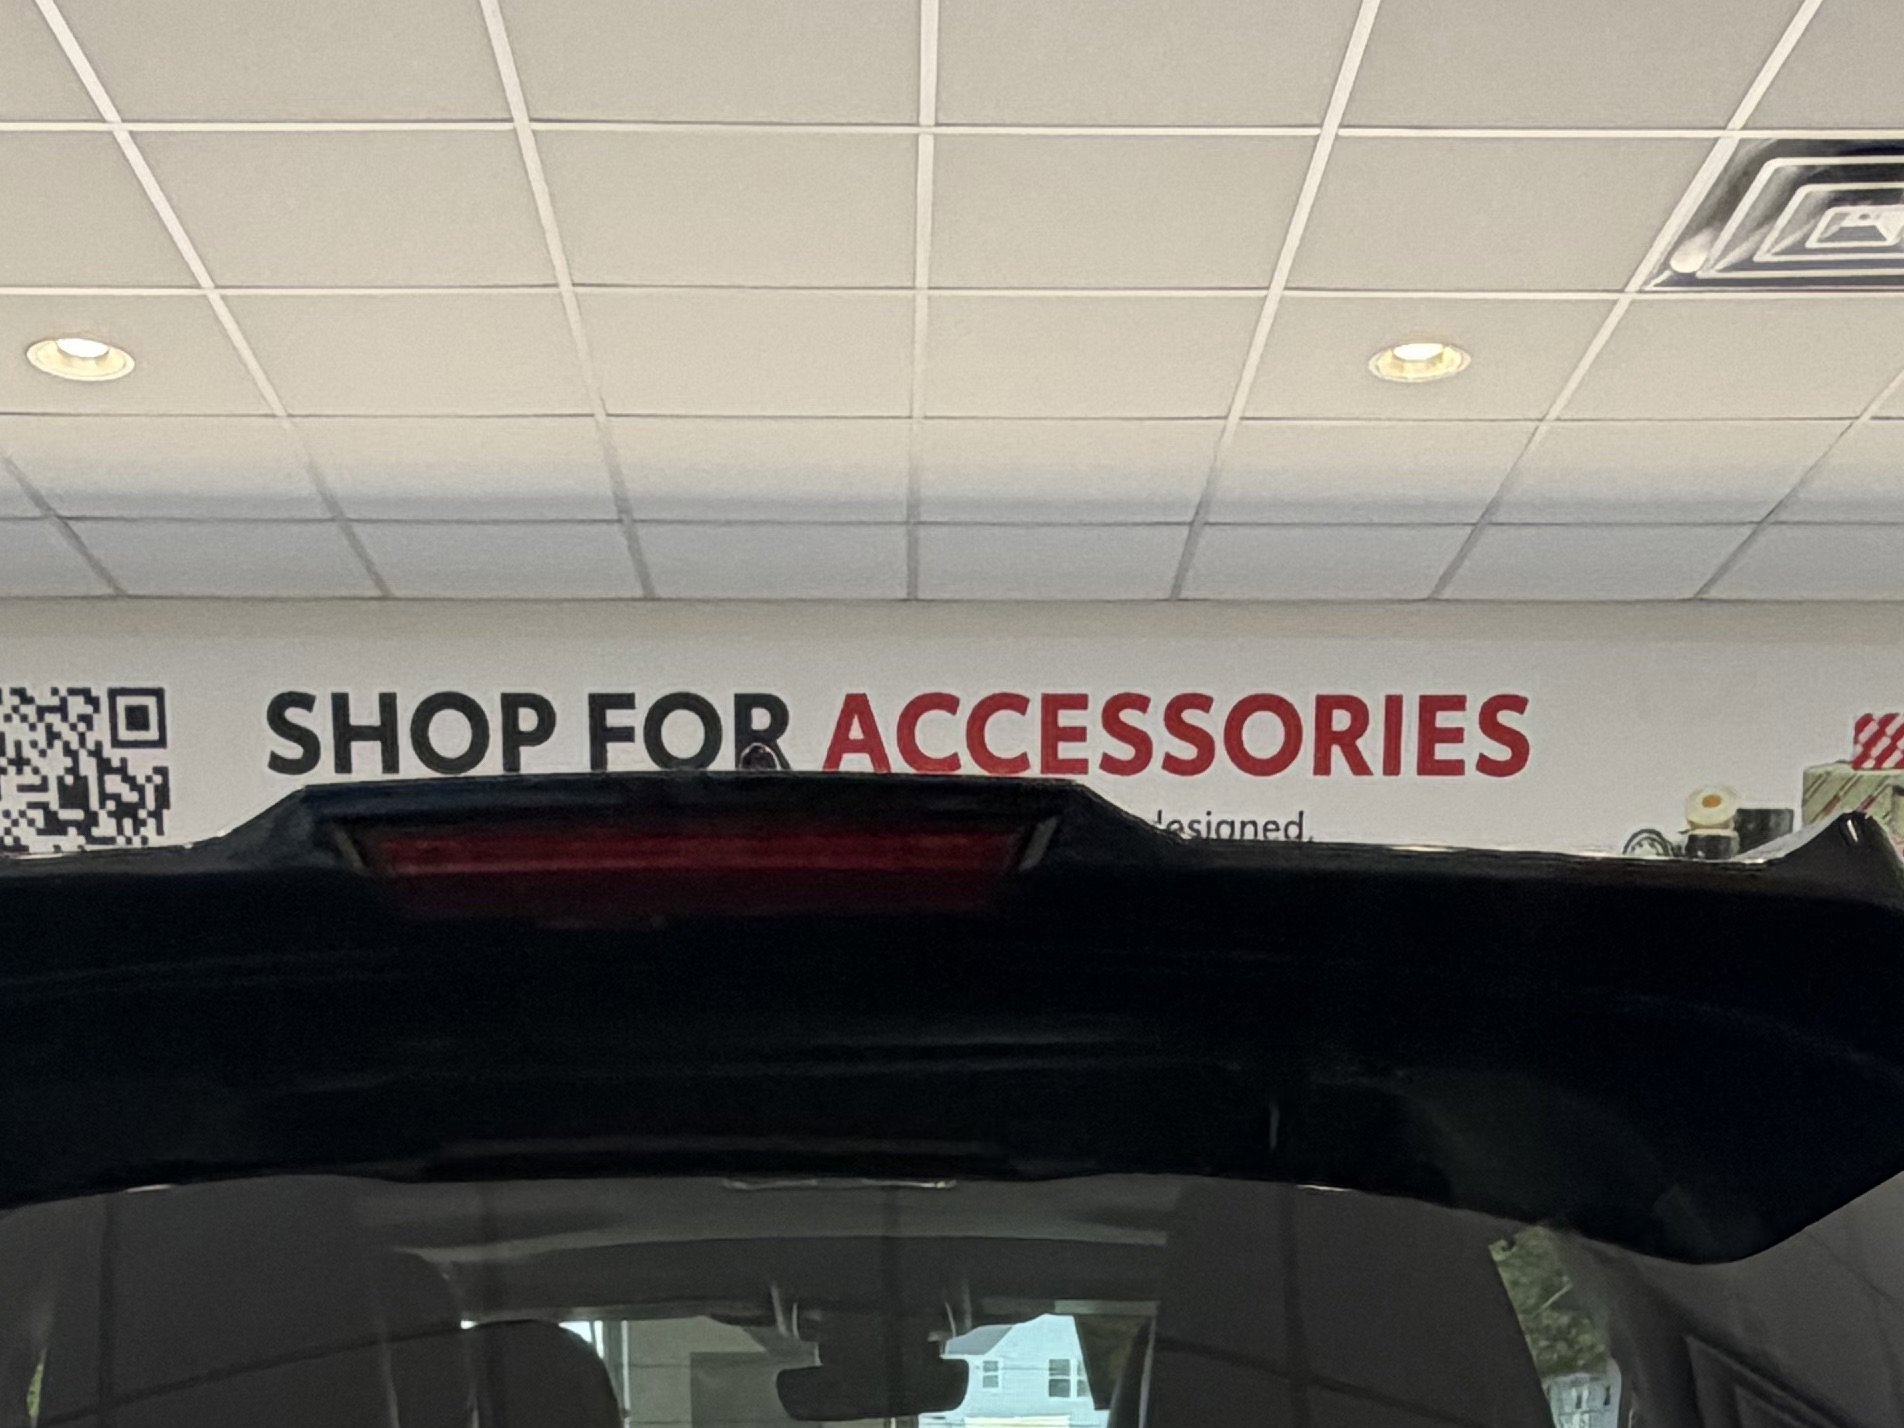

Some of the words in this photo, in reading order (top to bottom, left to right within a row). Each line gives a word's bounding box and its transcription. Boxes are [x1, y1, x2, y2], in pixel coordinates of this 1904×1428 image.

[267, 690, 556, 775] SHOP
[588, 691, 792, 771] FOR
[823, 691, 1531, 777] ACCESSORIES
